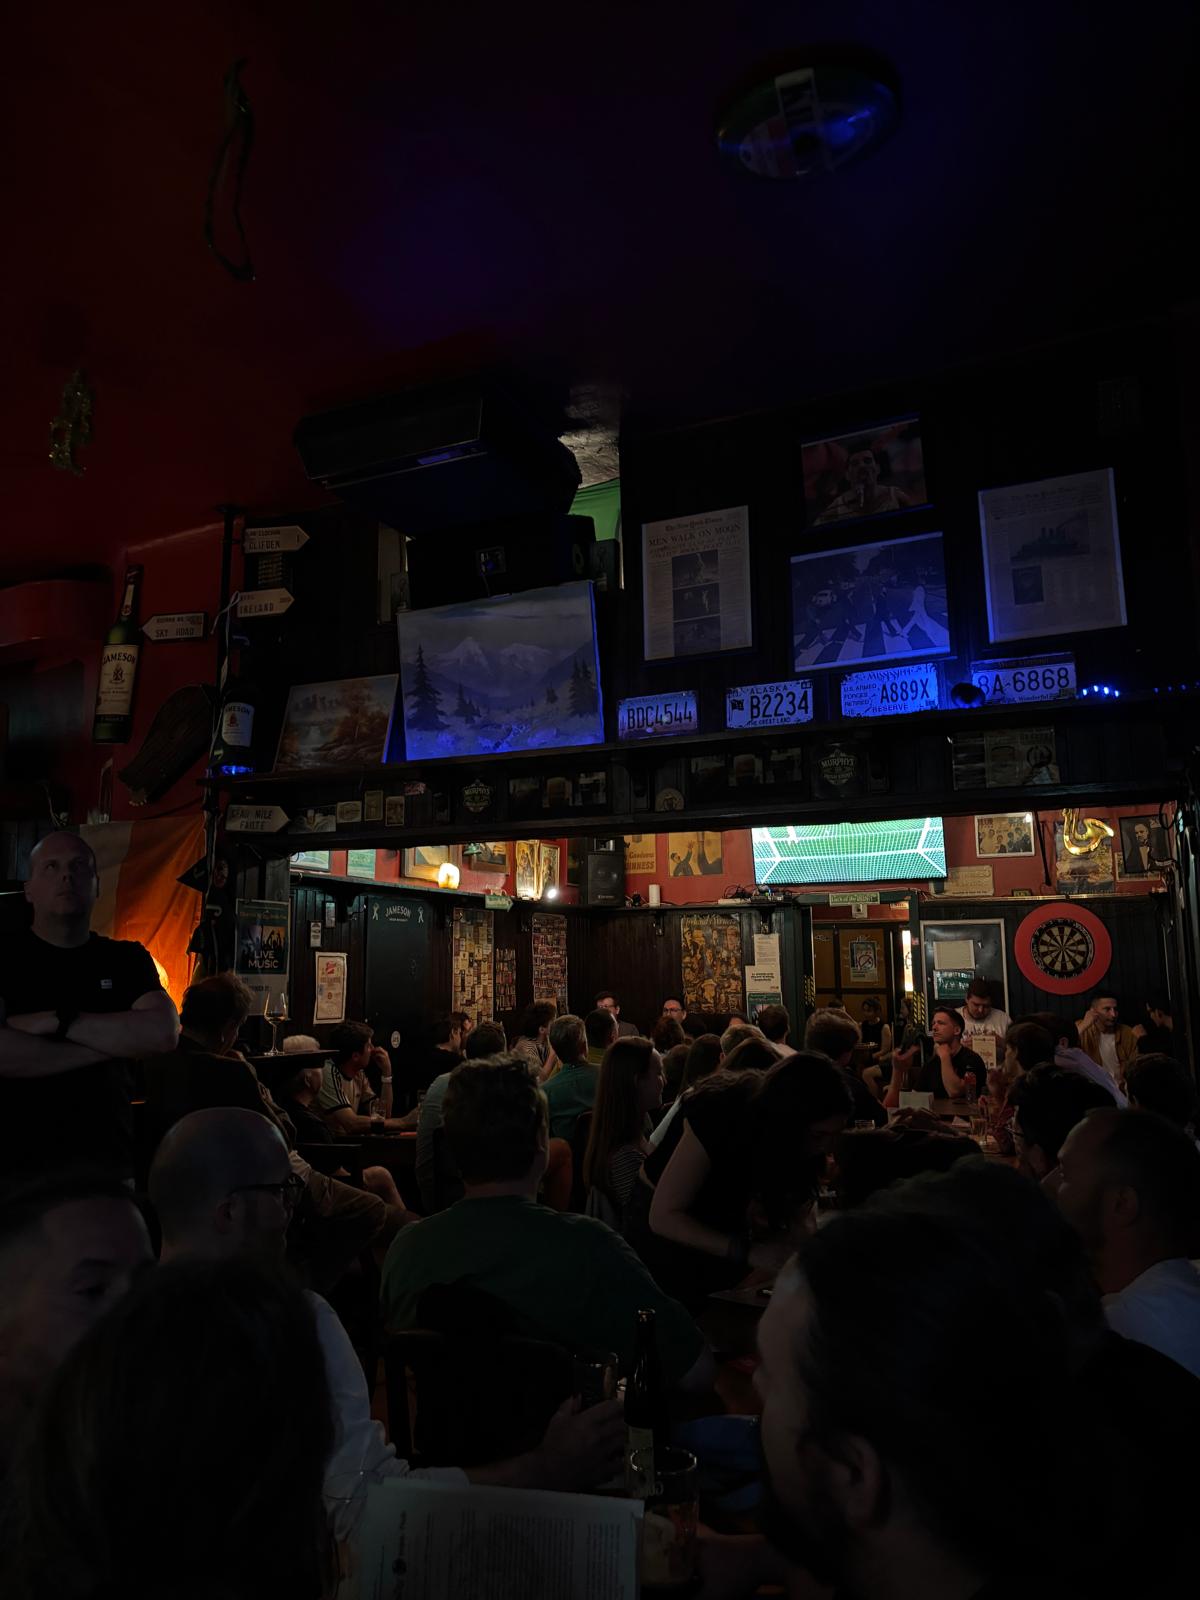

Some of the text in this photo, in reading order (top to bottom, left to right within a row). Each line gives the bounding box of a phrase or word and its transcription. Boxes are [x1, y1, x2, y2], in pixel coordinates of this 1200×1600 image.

[649, 523, 741, 546] MEN WALK ON MOON
[102, 652, 136, 666] JAMESON
[978, 667, 1070, 696] 8A-6868
[750, 685, 788, 695] ALASKA
[880, 678, 930, 704] A889X
[750, 690, 809, 719] B2234
[872, 704, 909, 713] RESERVE
[627, 701, 692, 730] BDC4544
[384, 904, 412, 918] JAMESON
[254, 950, 275, 960] LIVE
[248, 959, 280, 969] MUSIC
